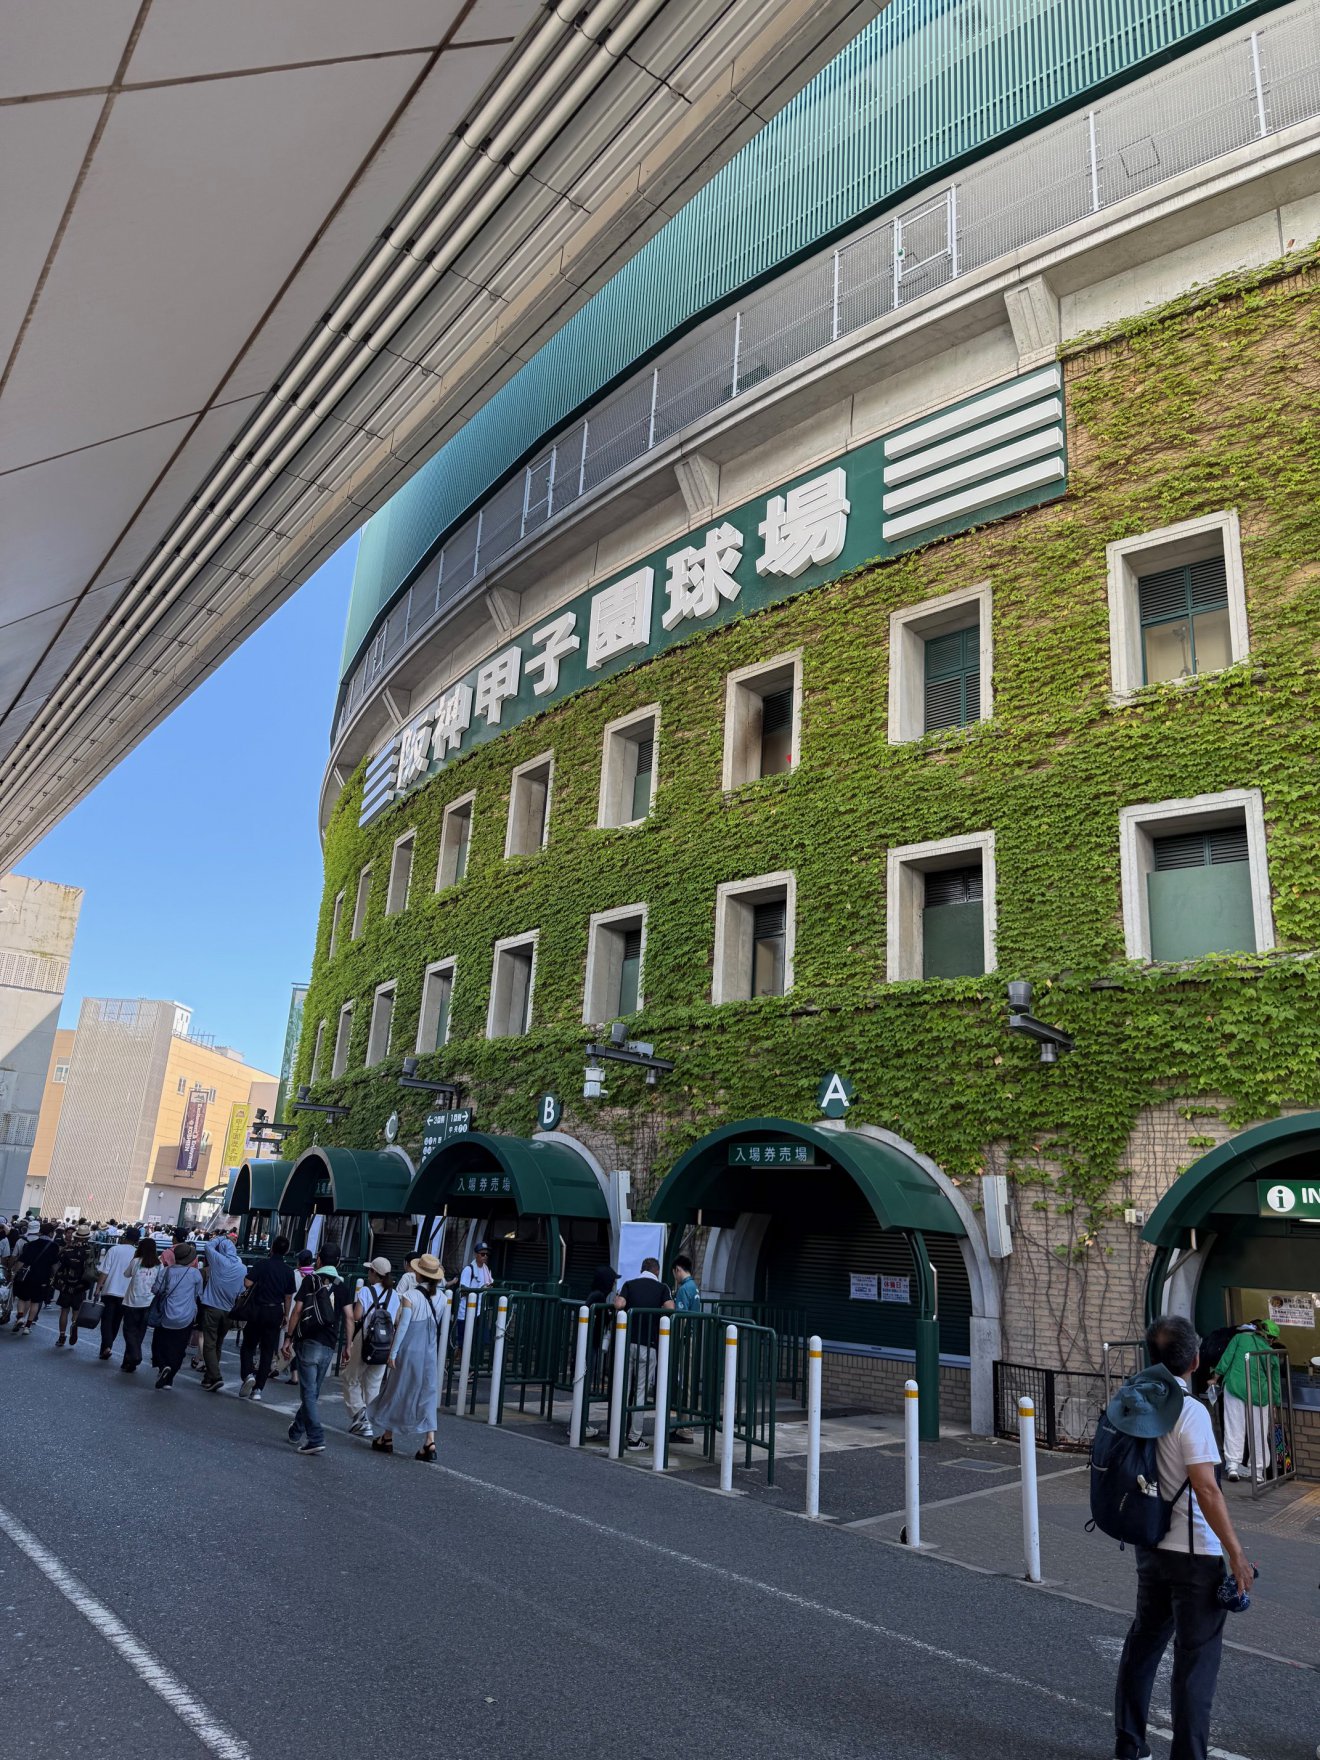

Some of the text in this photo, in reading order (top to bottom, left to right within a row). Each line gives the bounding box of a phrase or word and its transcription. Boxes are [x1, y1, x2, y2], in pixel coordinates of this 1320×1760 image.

[396, 466, 851, 790] 阪神甲子園球場
[820, 1073, 850, 1107] A
[543, 1096, 555, 1124] B
[185, 1127, 193, 1152] KOSHIEN
[187, 1140, 197, 1169] Enjoyment
[735, 1147, 808, 1162] 入場券売場
[457, 1177, 512, 1192] 入場券売場
